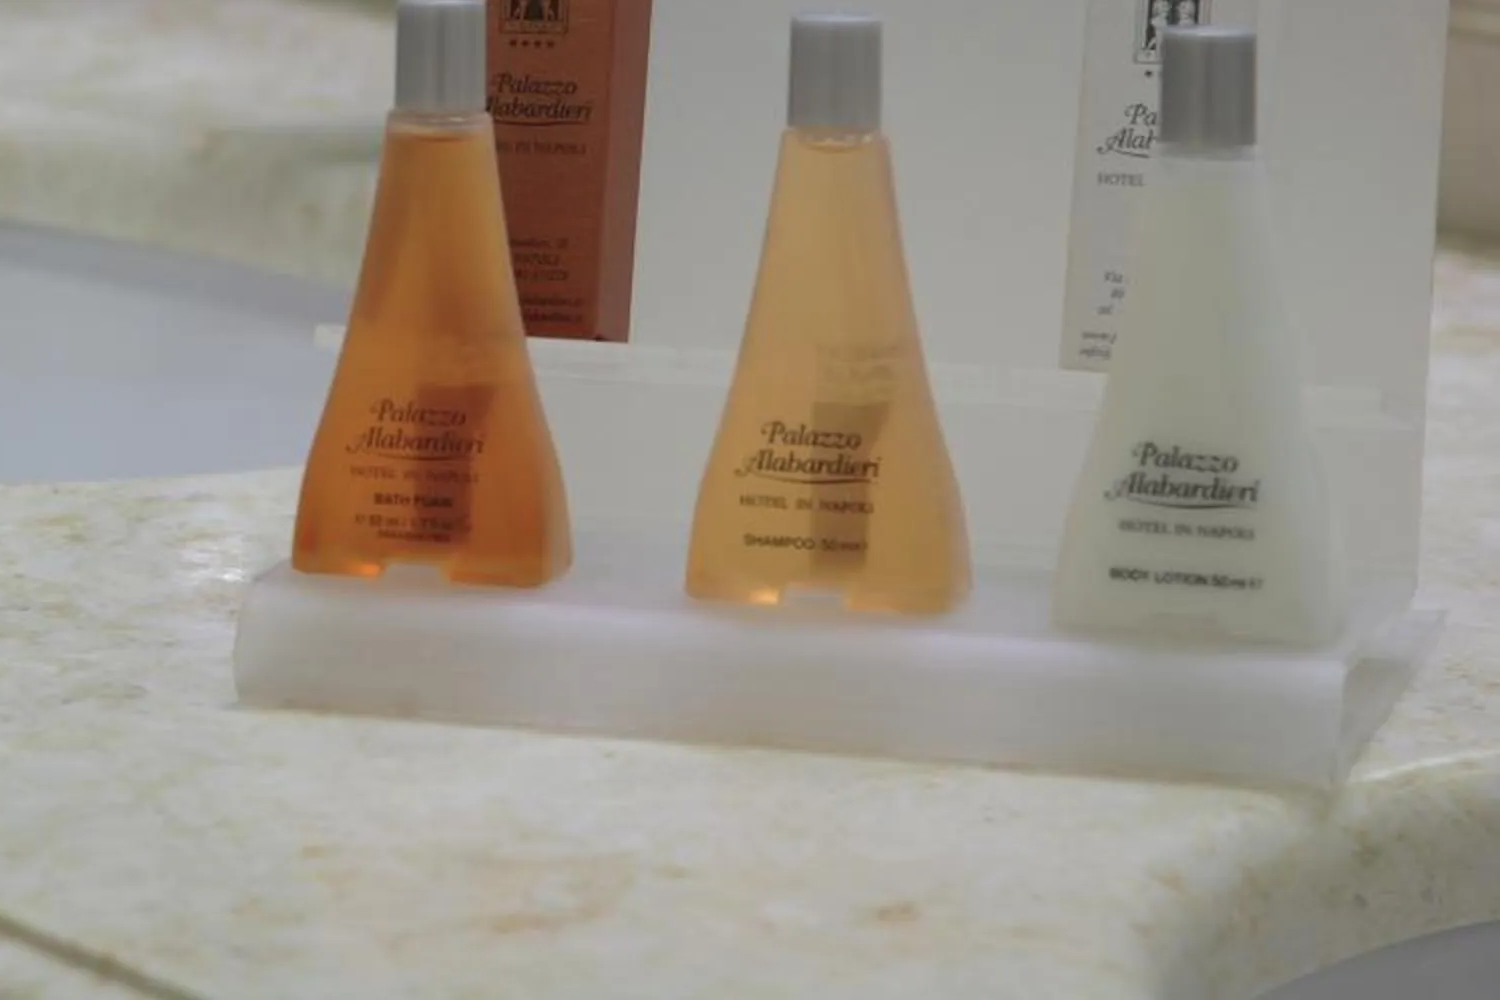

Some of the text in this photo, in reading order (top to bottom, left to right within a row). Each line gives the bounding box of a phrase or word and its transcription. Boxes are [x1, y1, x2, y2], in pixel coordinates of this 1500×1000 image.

[491, 71, 578, 96] Palazzo
[370, 398, 467, 427] Palazzo
[345, 425, 485, 456] Alabardieri
[760, 420, 863, 450] Palazzo
[734, 448, 884, 479] Alabardieri
[1132, 441, 1240, 474] Palazzo
[1103, 472, 1261, 502] Alabardieri
[739, 494, 788, 510] HOTEL
[1118, 519, 1171, 534] HOTEL
[743, 532, 816, 551] SHAMPOO
[1109, 567, 1149, 581] BODY
[1154, 571, 1208, 586] LOTION
